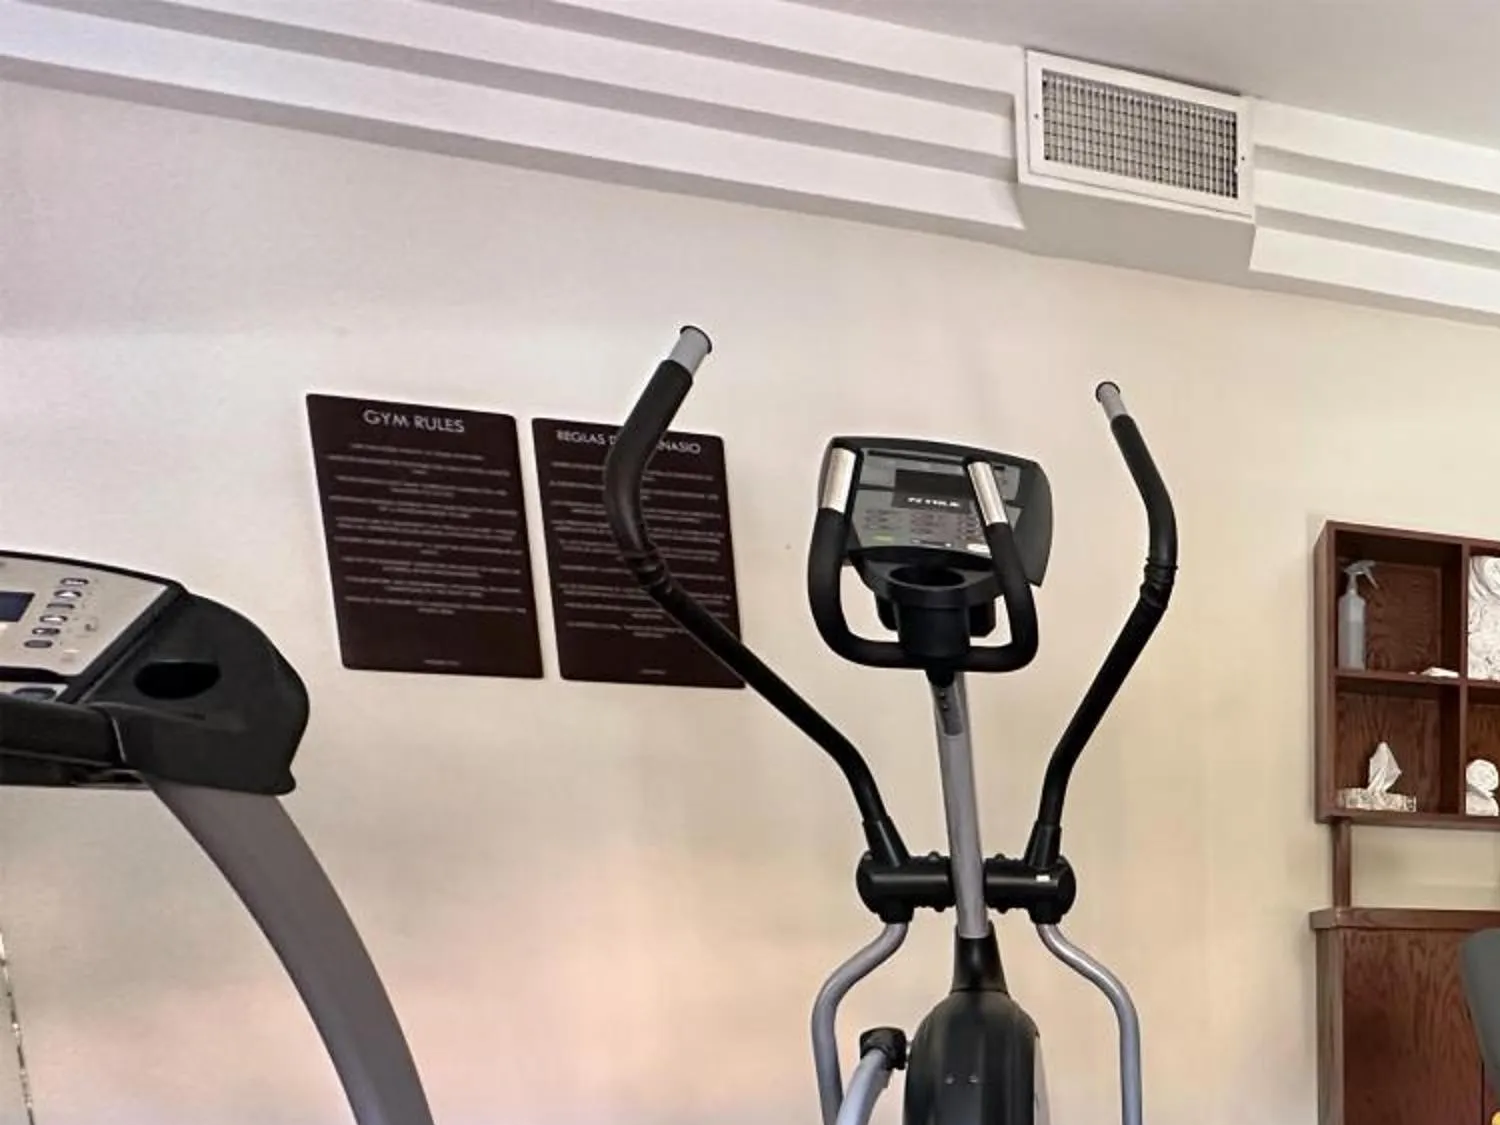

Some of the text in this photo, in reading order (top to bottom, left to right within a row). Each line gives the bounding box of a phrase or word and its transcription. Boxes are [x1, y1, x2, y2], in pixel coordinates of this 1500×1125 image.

[363, 409, 465, 433] GYM RULES
[556, 429, 606, 445] REGLAS
